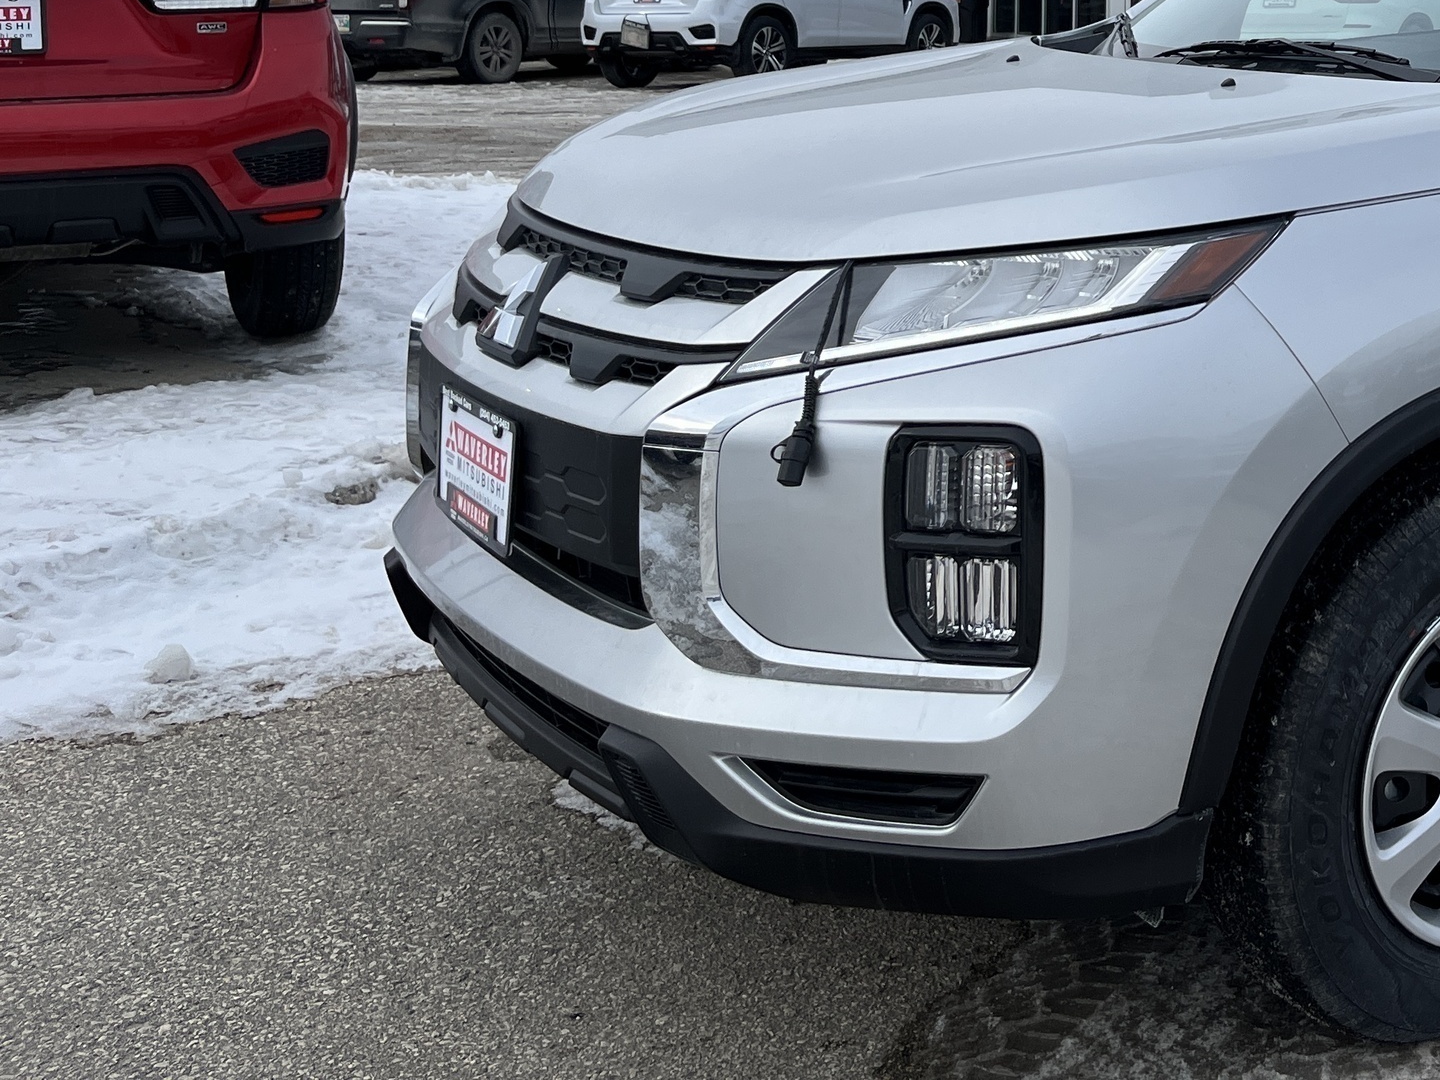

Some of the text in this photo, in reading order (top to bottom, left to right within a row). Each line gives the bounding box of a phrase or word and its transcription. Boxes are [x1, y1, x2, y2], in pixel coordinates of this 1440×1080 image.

[457, 427, 508, 479] WAVERLEY
[457, 455, 506, 501] MITSUBISHI
[457, 494, 490, 530] WAVERLEY
